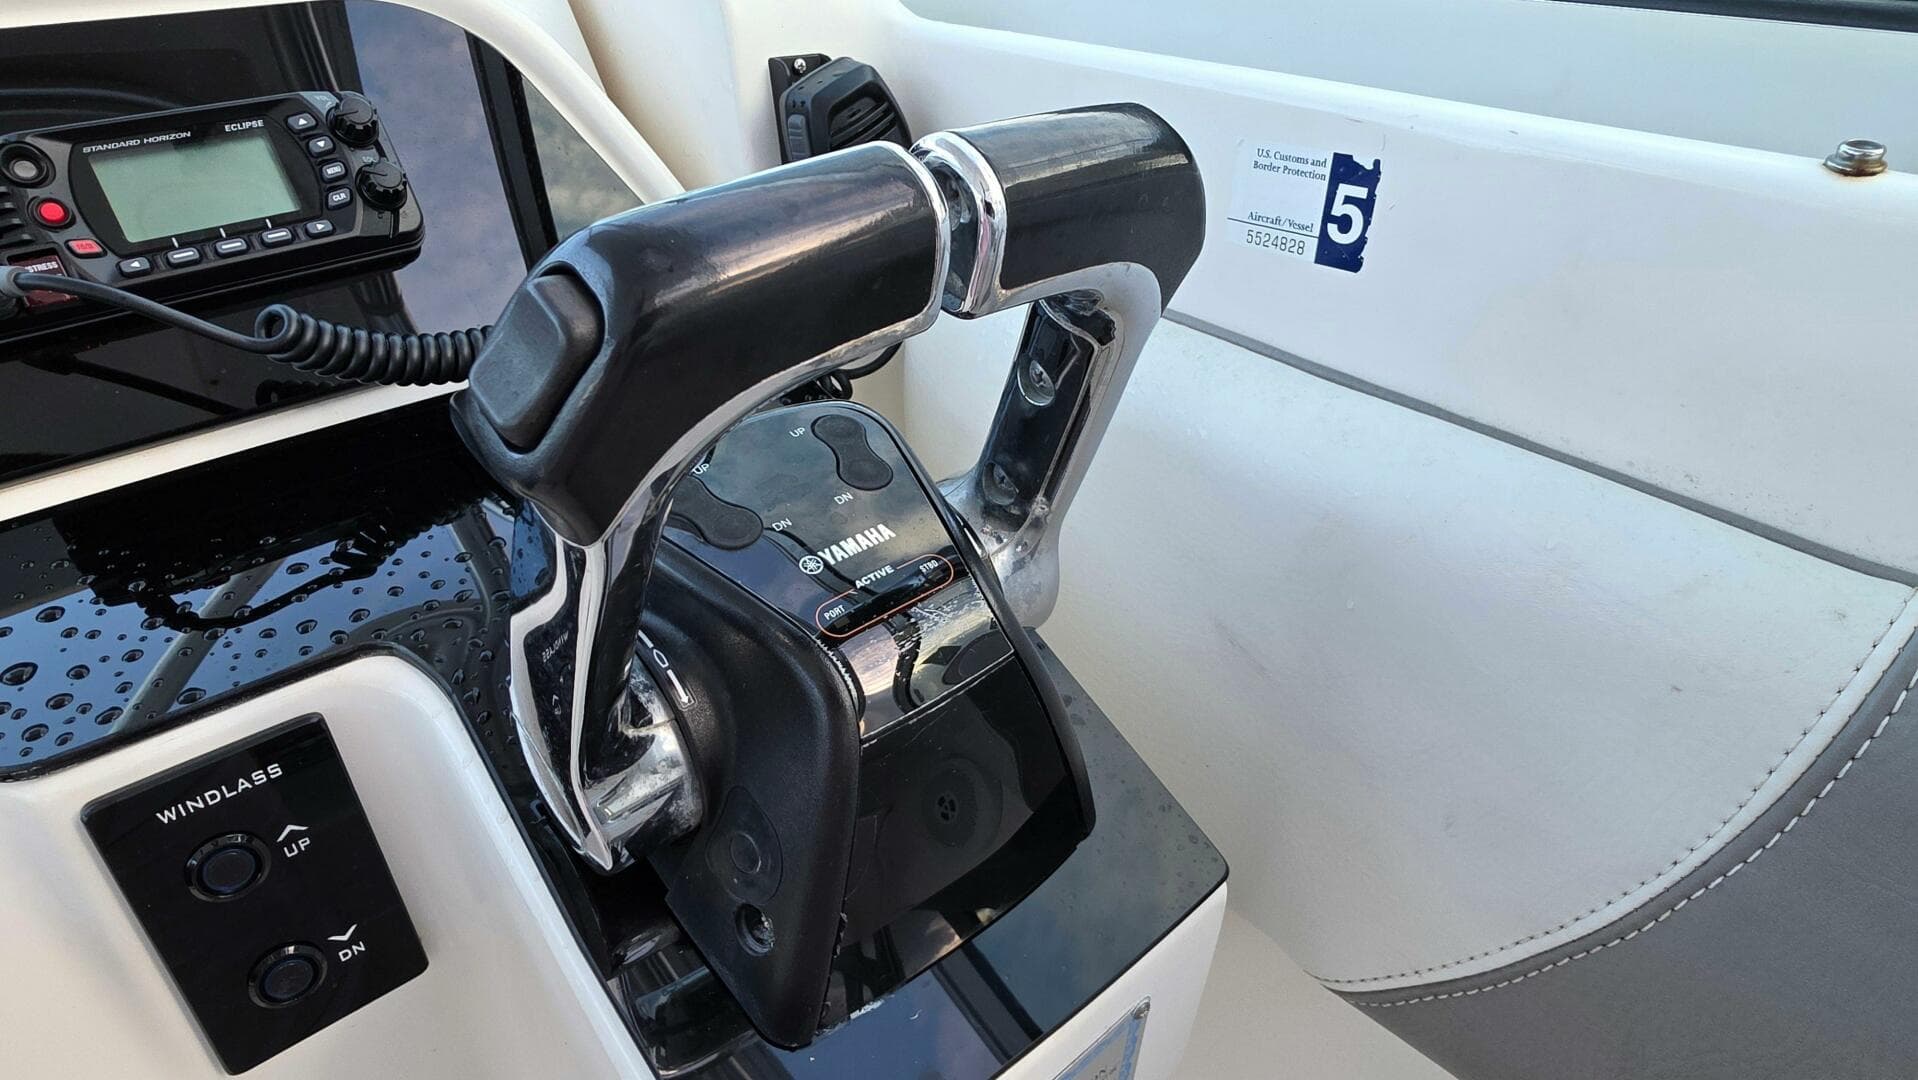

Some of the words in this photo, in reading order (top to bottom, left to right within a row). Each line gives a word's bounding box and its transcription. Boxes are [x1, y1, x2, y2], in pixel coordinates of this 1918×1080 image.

[224, 119, 265, 132] ECLIPSE
[82, 138, 141, 153] STANDARD
[143, 131, 192, 144] HORIZON
[1256, 147, 1272, 159] U.S.
[1273, 150, 1309, 165] Customs
[1310, 158, 1327, 169] and
[1253, 160, 1281, 173] Border
[1282, 166, 1327, 181] Protection
[332, 193, 347, 202] CLR
[1247, 211, 1314, 233] Aircraft/Vessel
[1326, 182, 1370, 246] 5
[1246, 229, 1306, 256] 5524828
[789, 427, 806, 438] UP
[692, 463, 710, 475] UP
[834, 492, 854, 505] DN
[771, 518, 793, 532] DN
[817, 523, 897, 566] YAMAHA
[919, 559, 939, 573] STBD
[854, 565, 895, 589] ACTIVE
[823, 604, 846, 621] PORT
[155, 763, 284, 825] WINDLASS
[283, 837, 311, 858] UP
[338, 941, 367, 963] DN
